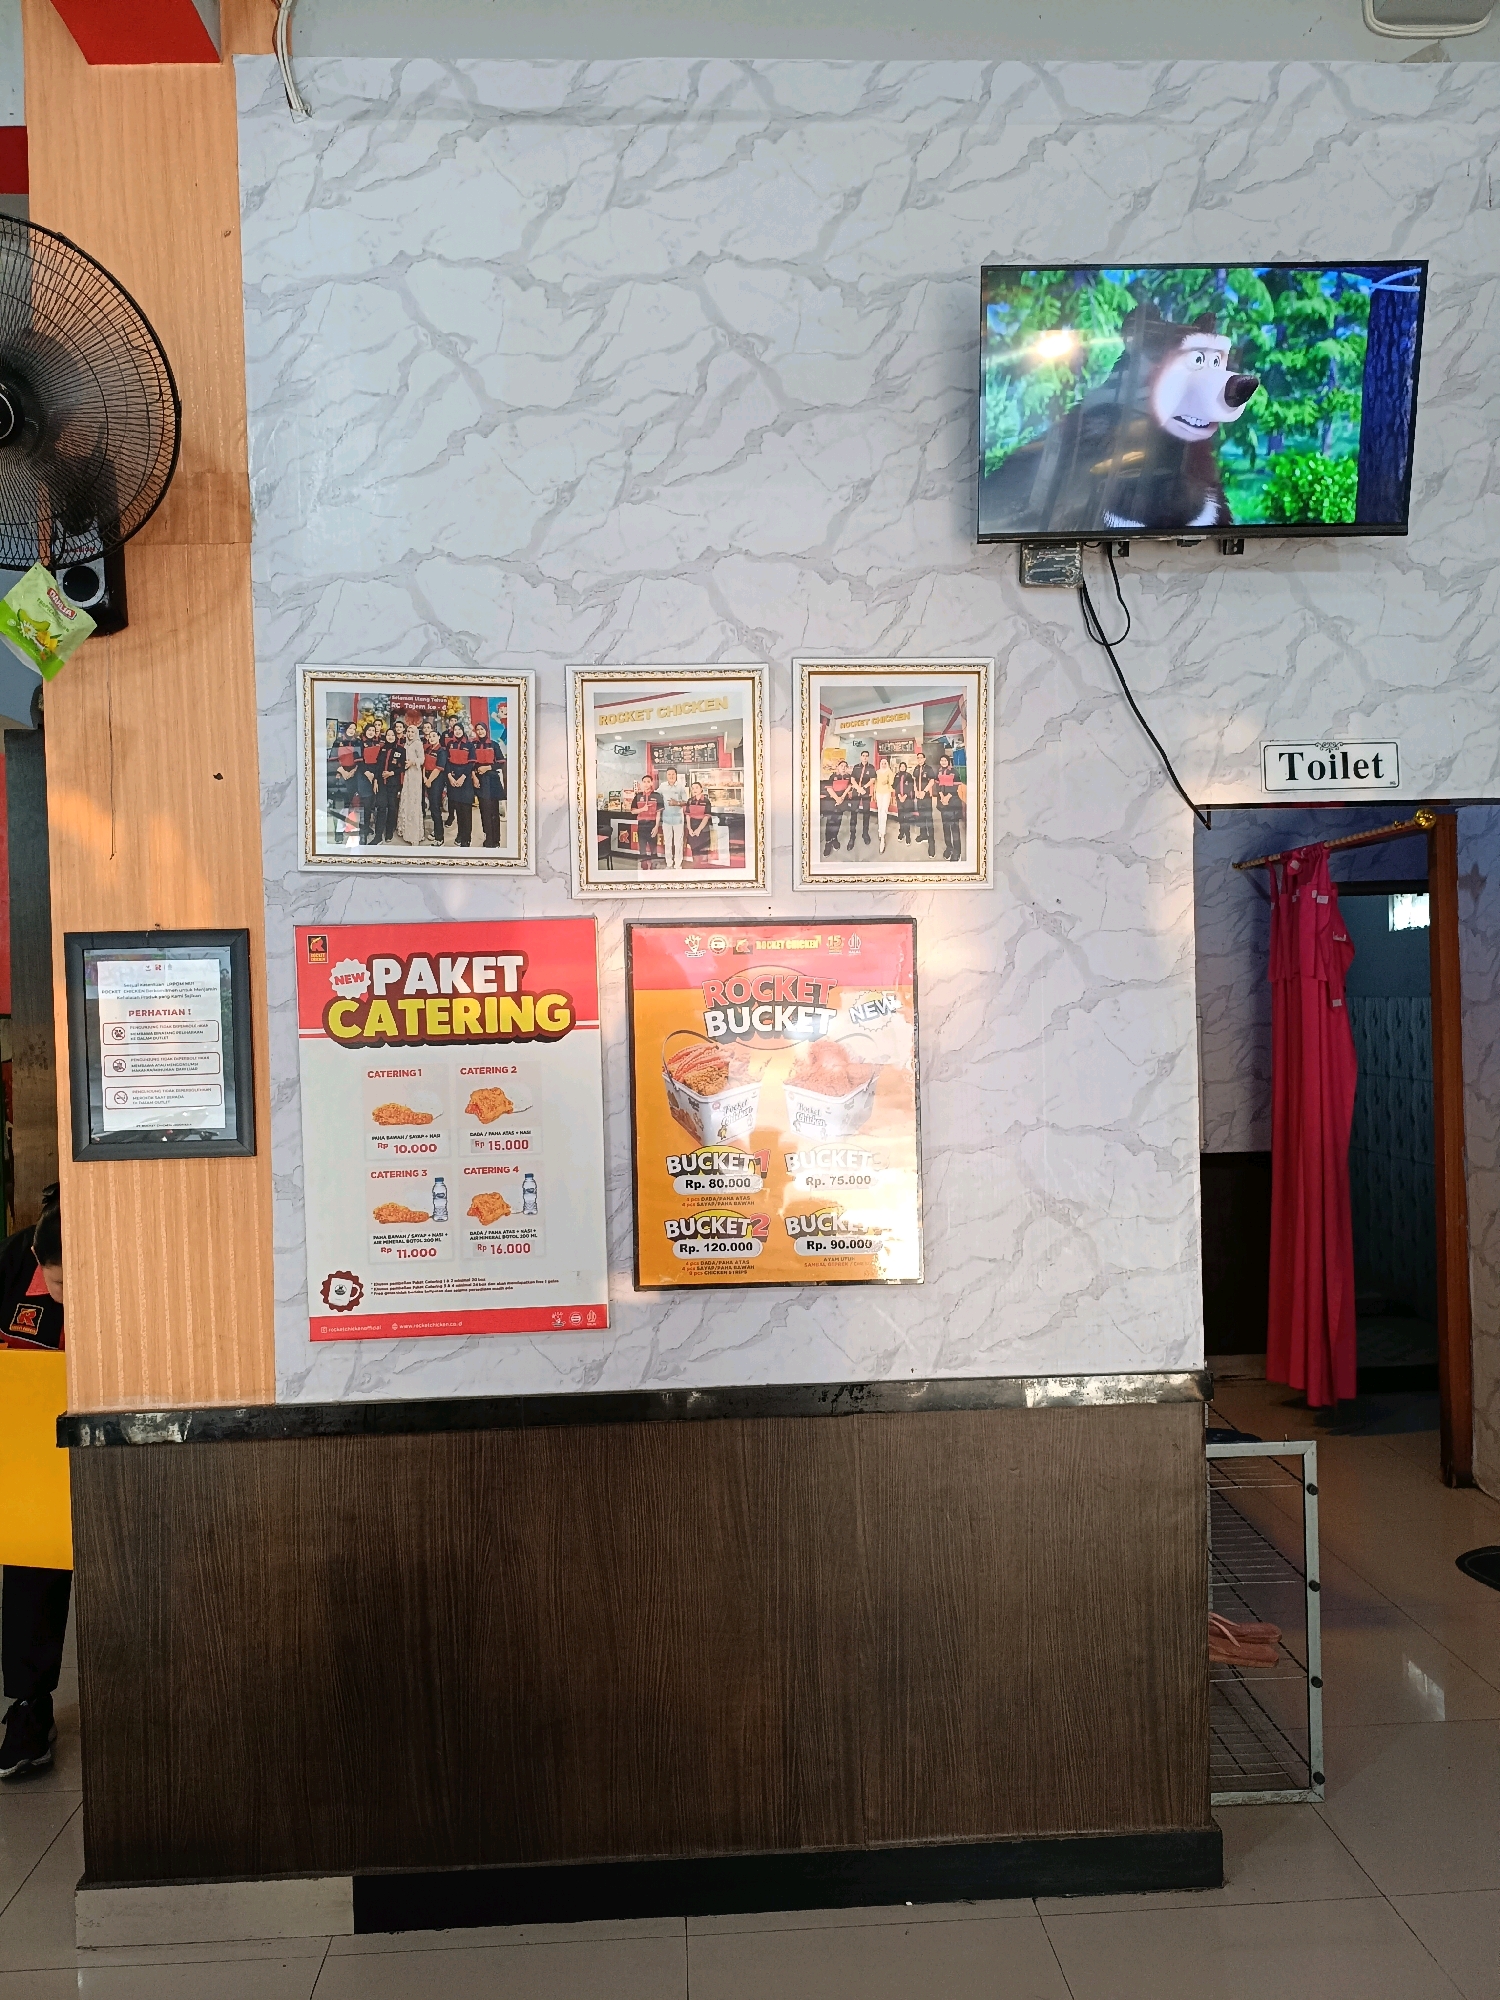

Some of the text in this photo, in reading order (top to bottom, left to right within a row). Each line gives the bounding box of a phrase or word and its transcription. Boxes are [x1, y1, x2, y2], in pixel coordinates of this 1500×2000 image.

[599, 696, 729, 726] ROCKET CHICKEN
[840, 712, 910, 729] ROCKET CHICKEN
[1278, 752, 1384, 781] Toilet
[334, 972, 365, 985] NEW
[372, 956, 524, 996] PAKET
[702, 974, 837, 1008] ROCKET
[129, 1009, 185, 1017] PERHATIAN
[848, 995, 896, 1023] NEW
[328, 994, 571, 1038] CATERING
[703, 1005, 836, 1038] BUCKET
[367, 1069, 422, 1079] CATERING 1
[460, 1066, 517, 1075] CATERING 2
[394, 1143, 437, 1154] 10.000
[475, 1140, 529, 1150] Rp 15.000
[666, 1149, 771, 1174] BUCKET 1
[785, 1149, 872, 1172] BUCKET
[371, 1169, 427, 1179] CATERING 3
[463, 1166, 510, 1175] CATERING
[685, 1177, 751, 1190] Rp. 80.000
[806, 1175, 871, 1188] Rp. 75.000
[665, 1213, 770, 1238] BUCKET 2
[477, 1243, 531, 1254] Rp 16.000
[680, 1242, 753, 1254] Rp. 120.000
[806, 1239, 873, 1251] Rp. 90.000
[397, 1248, 437, 1258] 11.000
[328, 1325, 381, 1333] rocketchickenofficial
